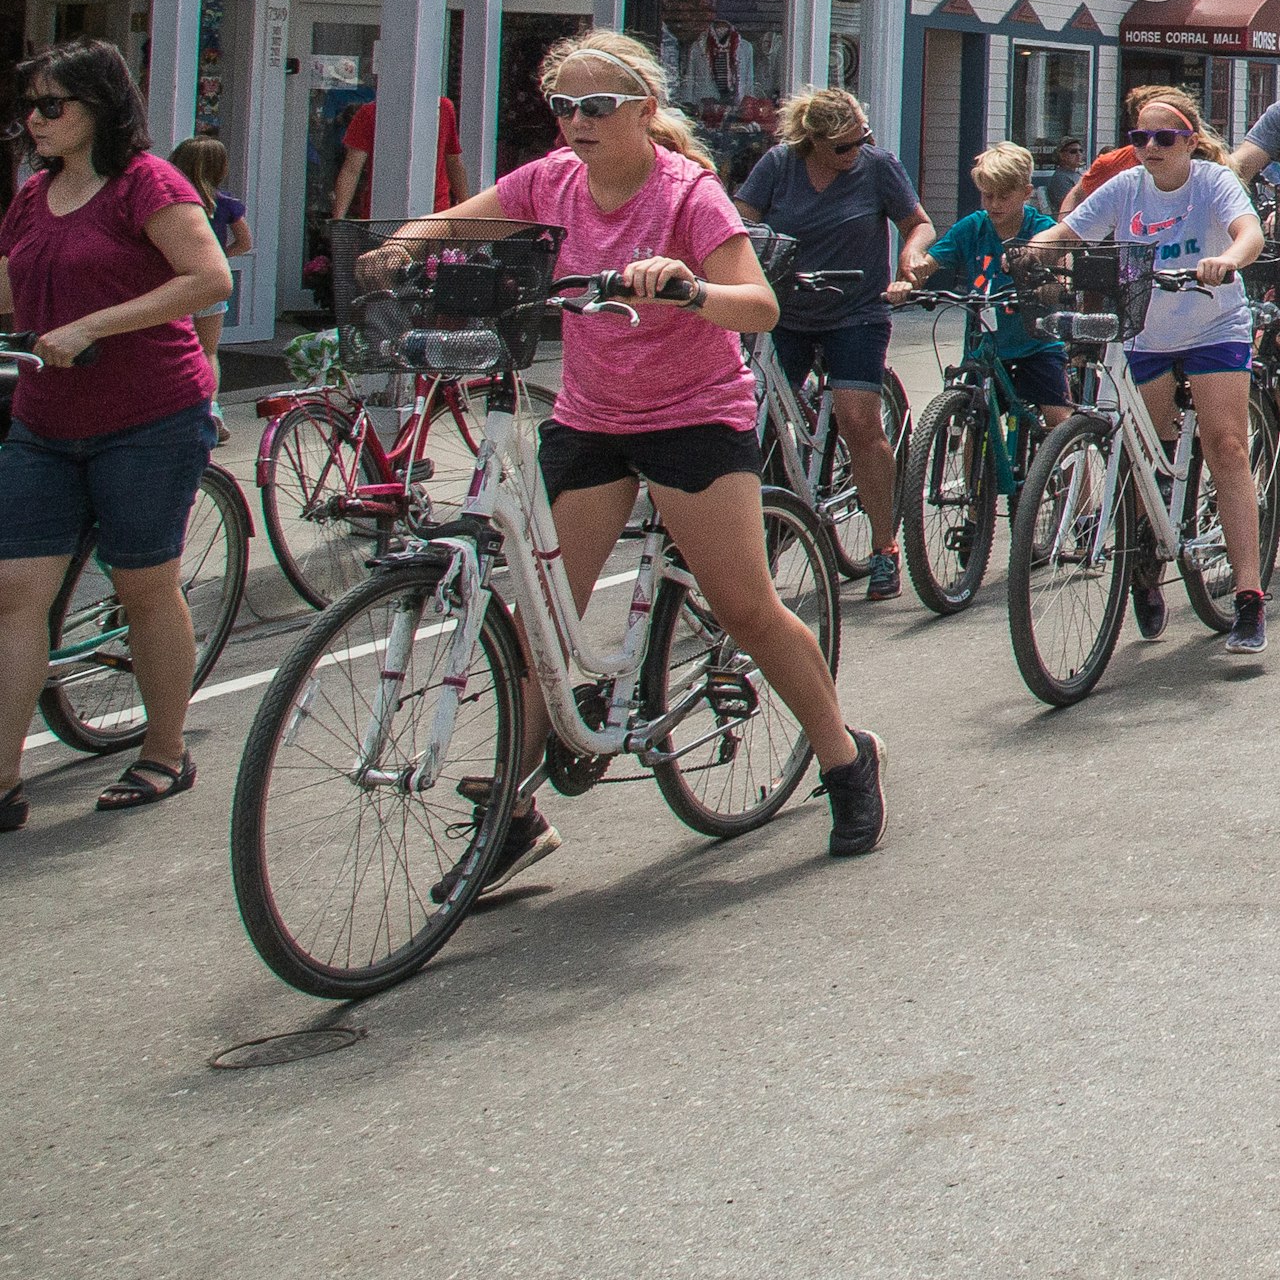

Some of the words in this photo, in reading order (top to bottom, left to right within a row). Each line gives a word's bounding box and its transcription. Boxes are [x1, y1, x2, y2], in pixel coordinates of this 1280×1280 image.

[1125, 31, 1161, 44] HORSE
[1165, 31, 1209, 44] CORRAL
[1213, 33, 1242, 45] MALL
[1253, 31, 1277, 50] HORSE
[1160, 242, 1182, 261] DO
